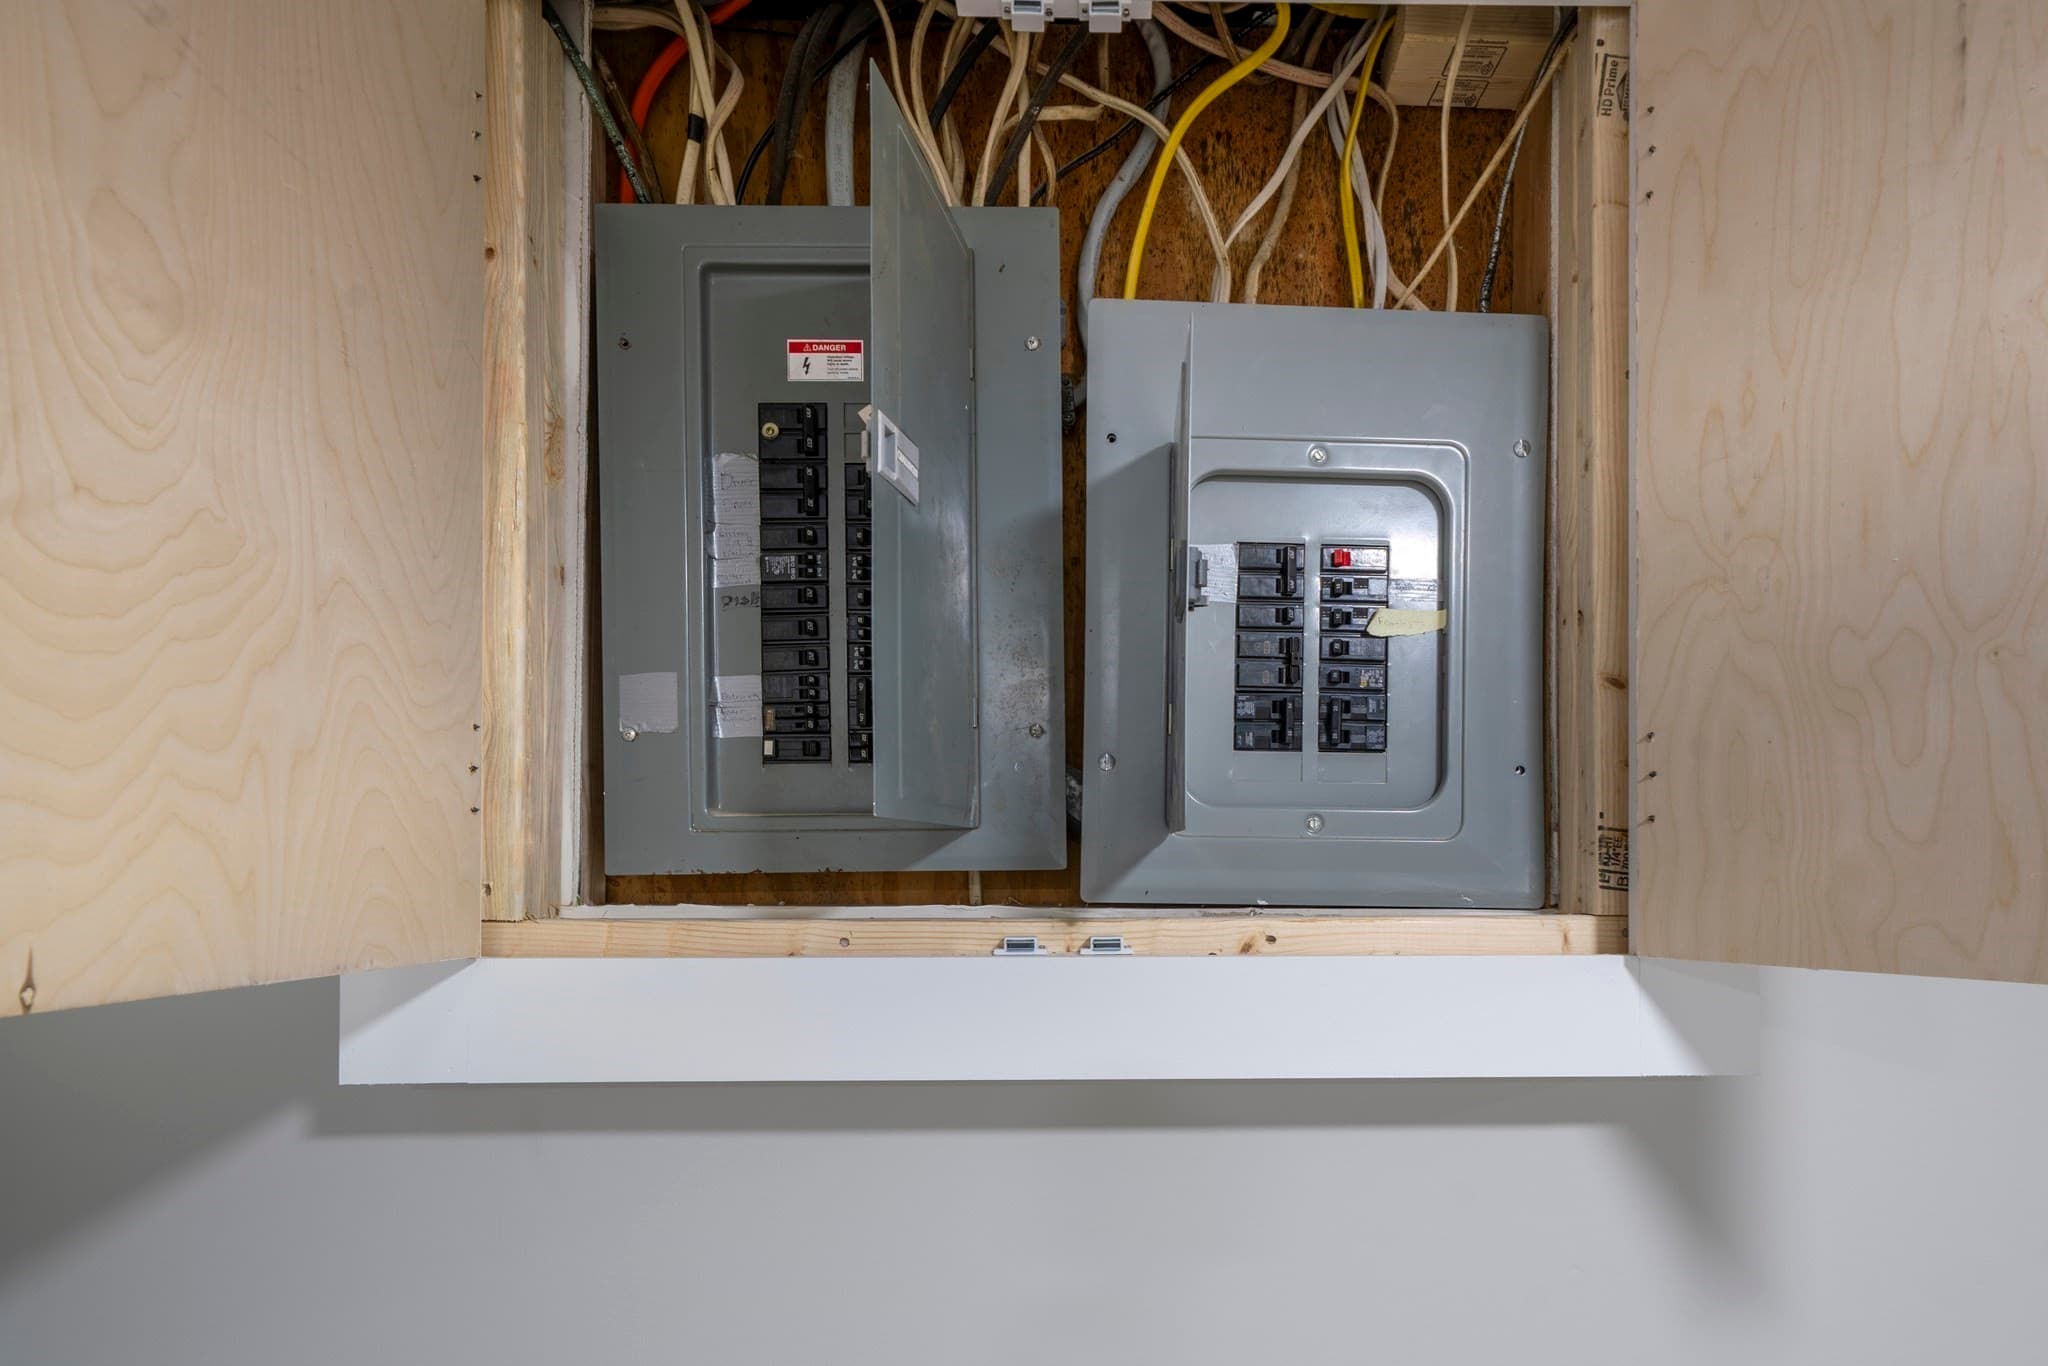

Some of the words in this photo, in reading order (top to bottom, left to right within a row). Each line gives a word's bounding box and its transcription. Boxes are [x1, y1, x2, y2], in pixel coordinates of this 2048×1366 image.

[1603, 60, 1618, 97] Prime
[1601, 99, 1613, 117] HD
[812, 344, 847, 352] DANGER
